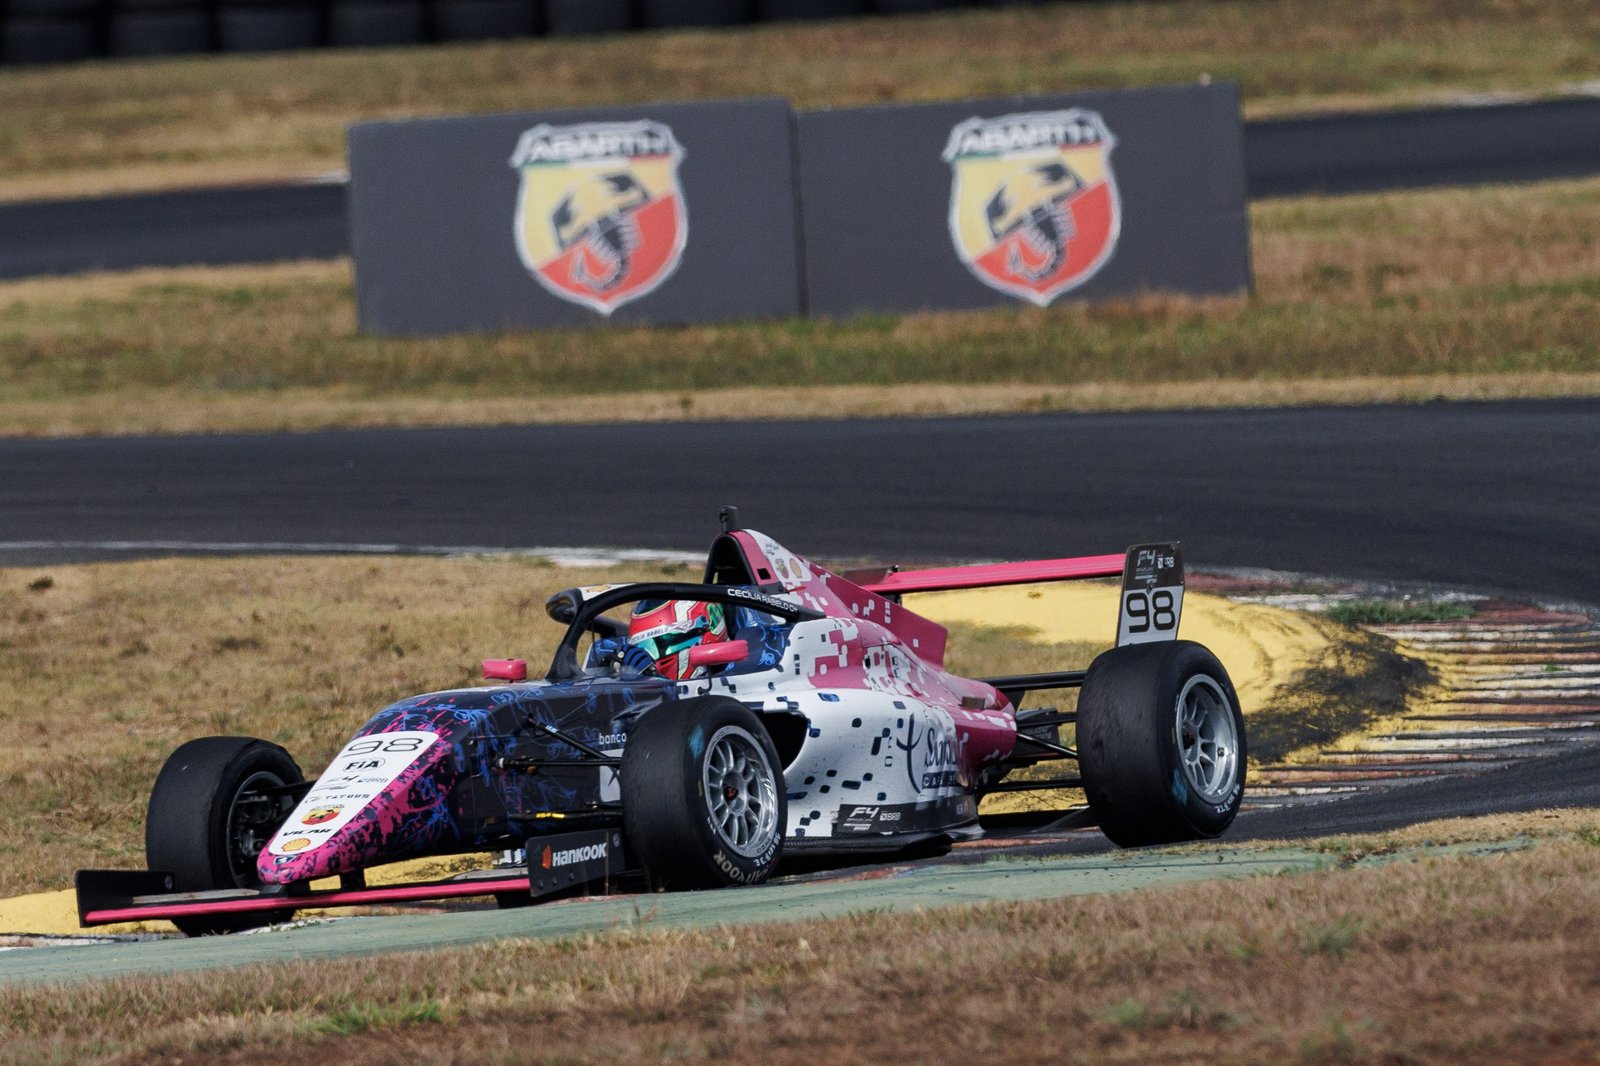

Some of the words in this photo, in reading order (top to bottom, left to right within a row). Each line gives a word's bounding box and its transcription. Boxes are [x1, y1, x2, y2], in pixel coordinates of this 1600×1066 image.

[1137, 550, 1156, 567] F4
[762, 595, 789, 610] RABELO
[1126, 590, 1176, 634] 98
[599, 732, 627, 745] banco
[342, 738, 423, 758] 98
[849, 806, 880, 819] F4
